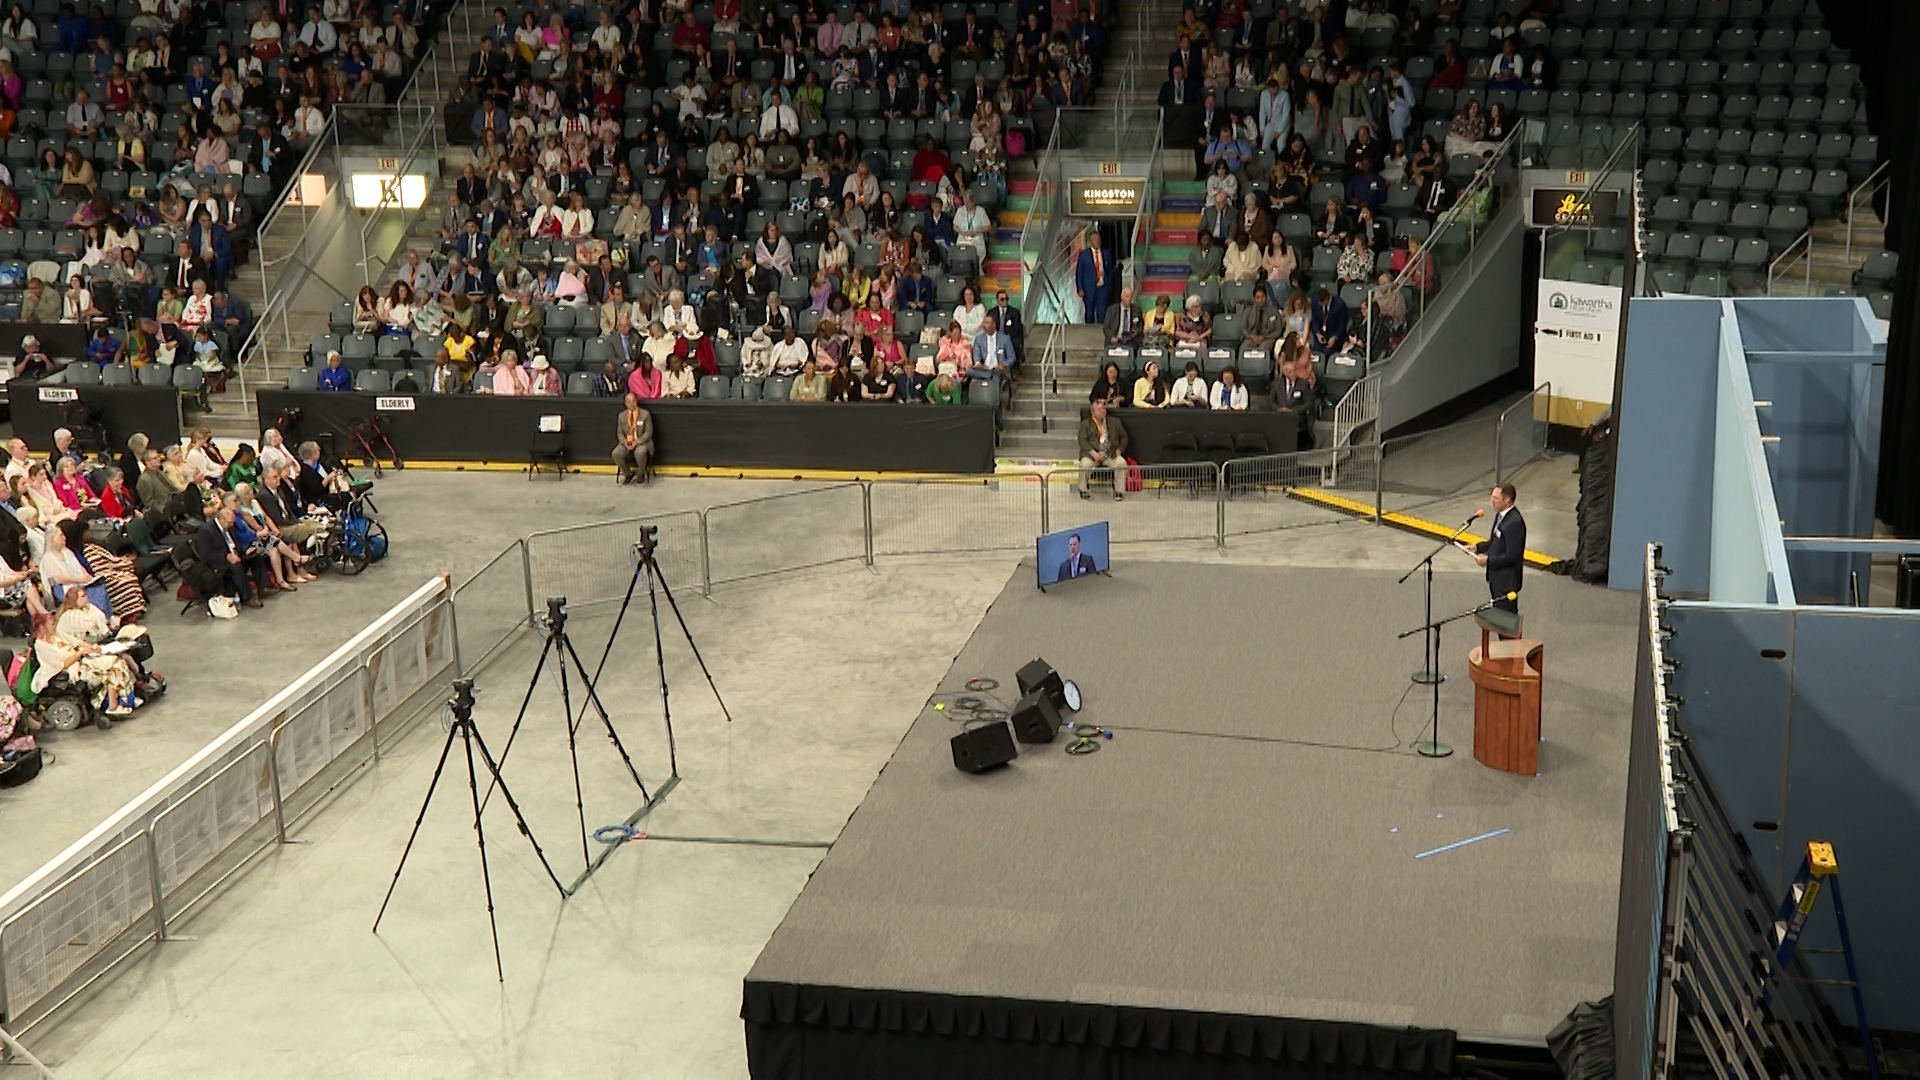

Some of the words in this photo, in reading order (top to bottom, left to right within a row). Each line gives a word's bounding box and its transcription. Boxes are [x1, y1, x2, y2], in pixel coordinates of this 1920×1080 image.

[1103, 163, 1118, 174] EXIT
[1570, 171, 1586, 184] EXIT
[1084, 189, 1135, 199] KINGSTON
